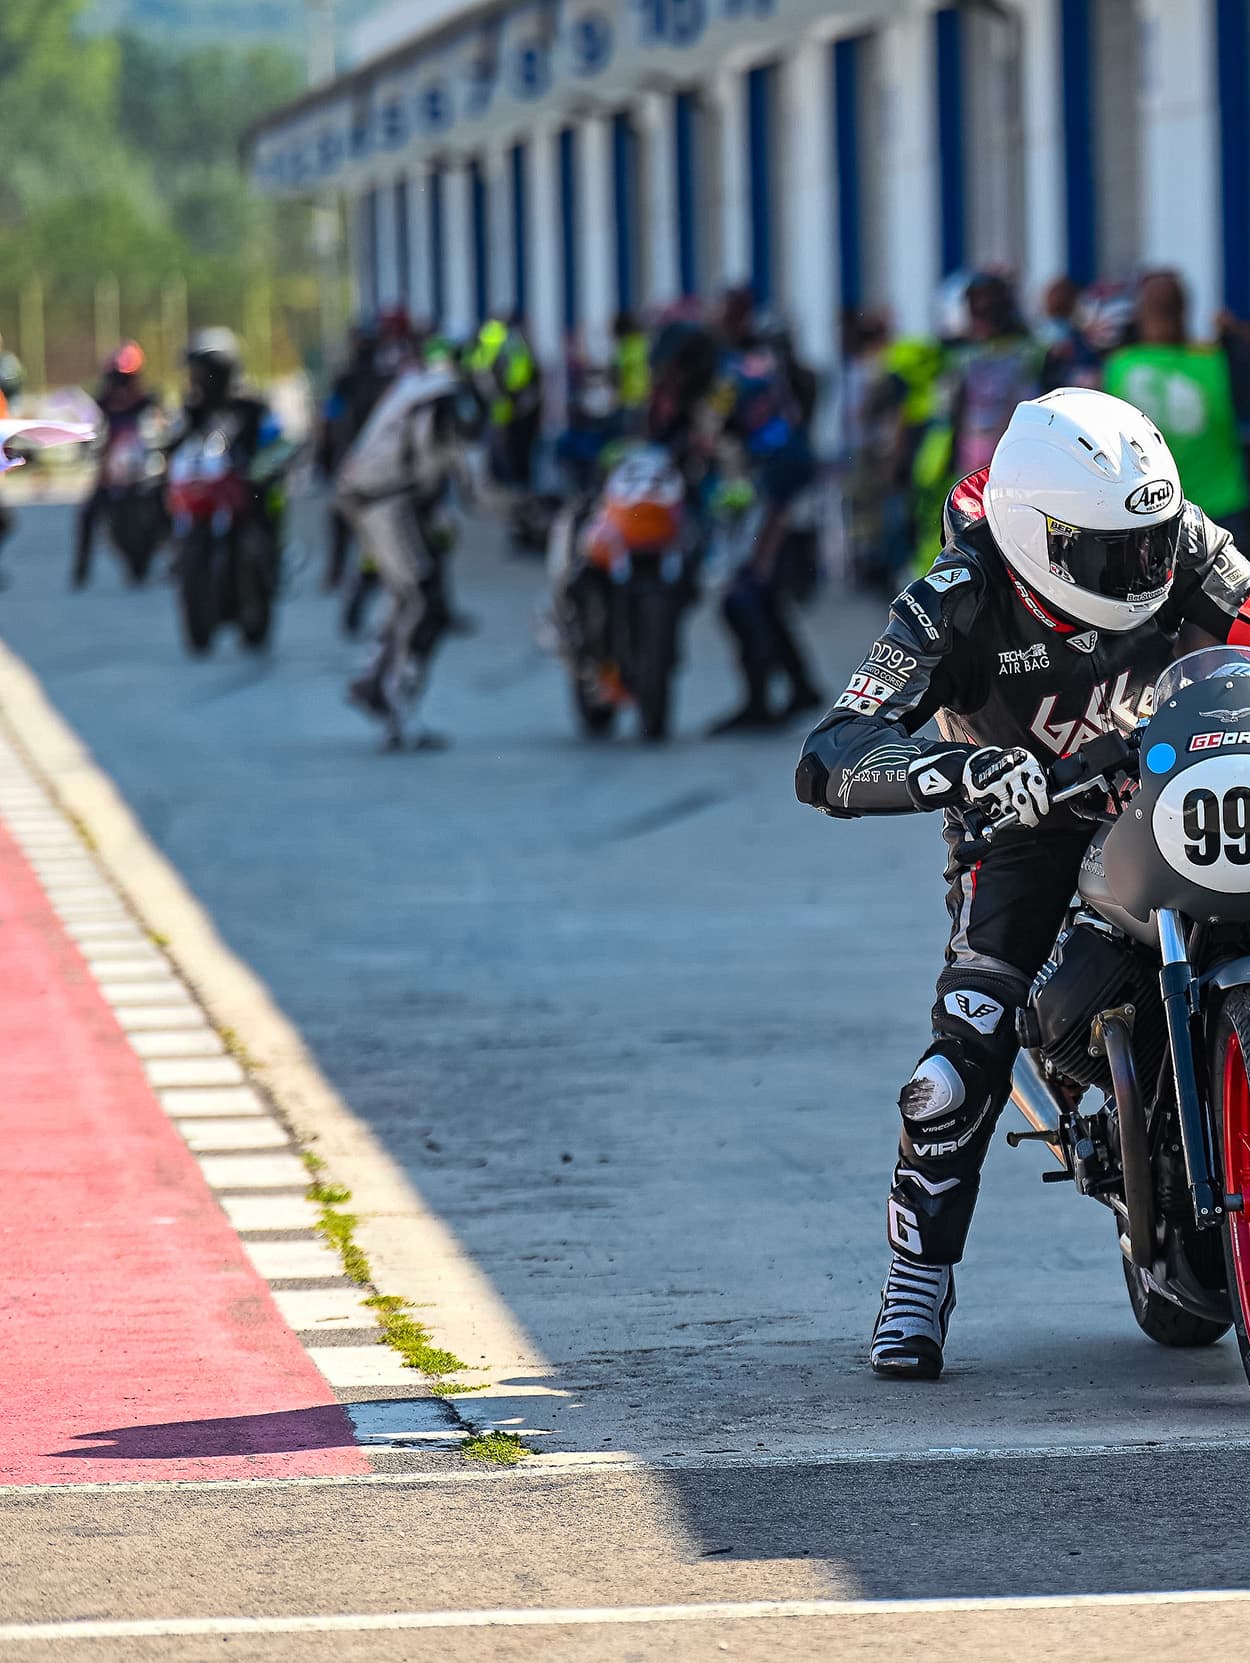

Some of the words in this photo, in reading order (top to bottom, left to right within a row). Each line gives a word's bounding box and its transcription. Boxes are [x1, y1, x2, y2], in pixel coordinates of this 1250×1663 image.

[1130, 481, 1171, 511] Arai
[1050, 520, 1073, 535] BER
[869, 641, 918, 679] DD92
[998, 650, 1023, 664] TECH
[998, 661, 1022, 675] AIR
[1024, 655, 1051, 673] BAG
[880, 671, 906, 690] CORSE
[912, 1093, 992, 1158] VIRCOS
[922, 1118, 957, 1134] VIRCOS
[888, 1199, 923, 1256] G
